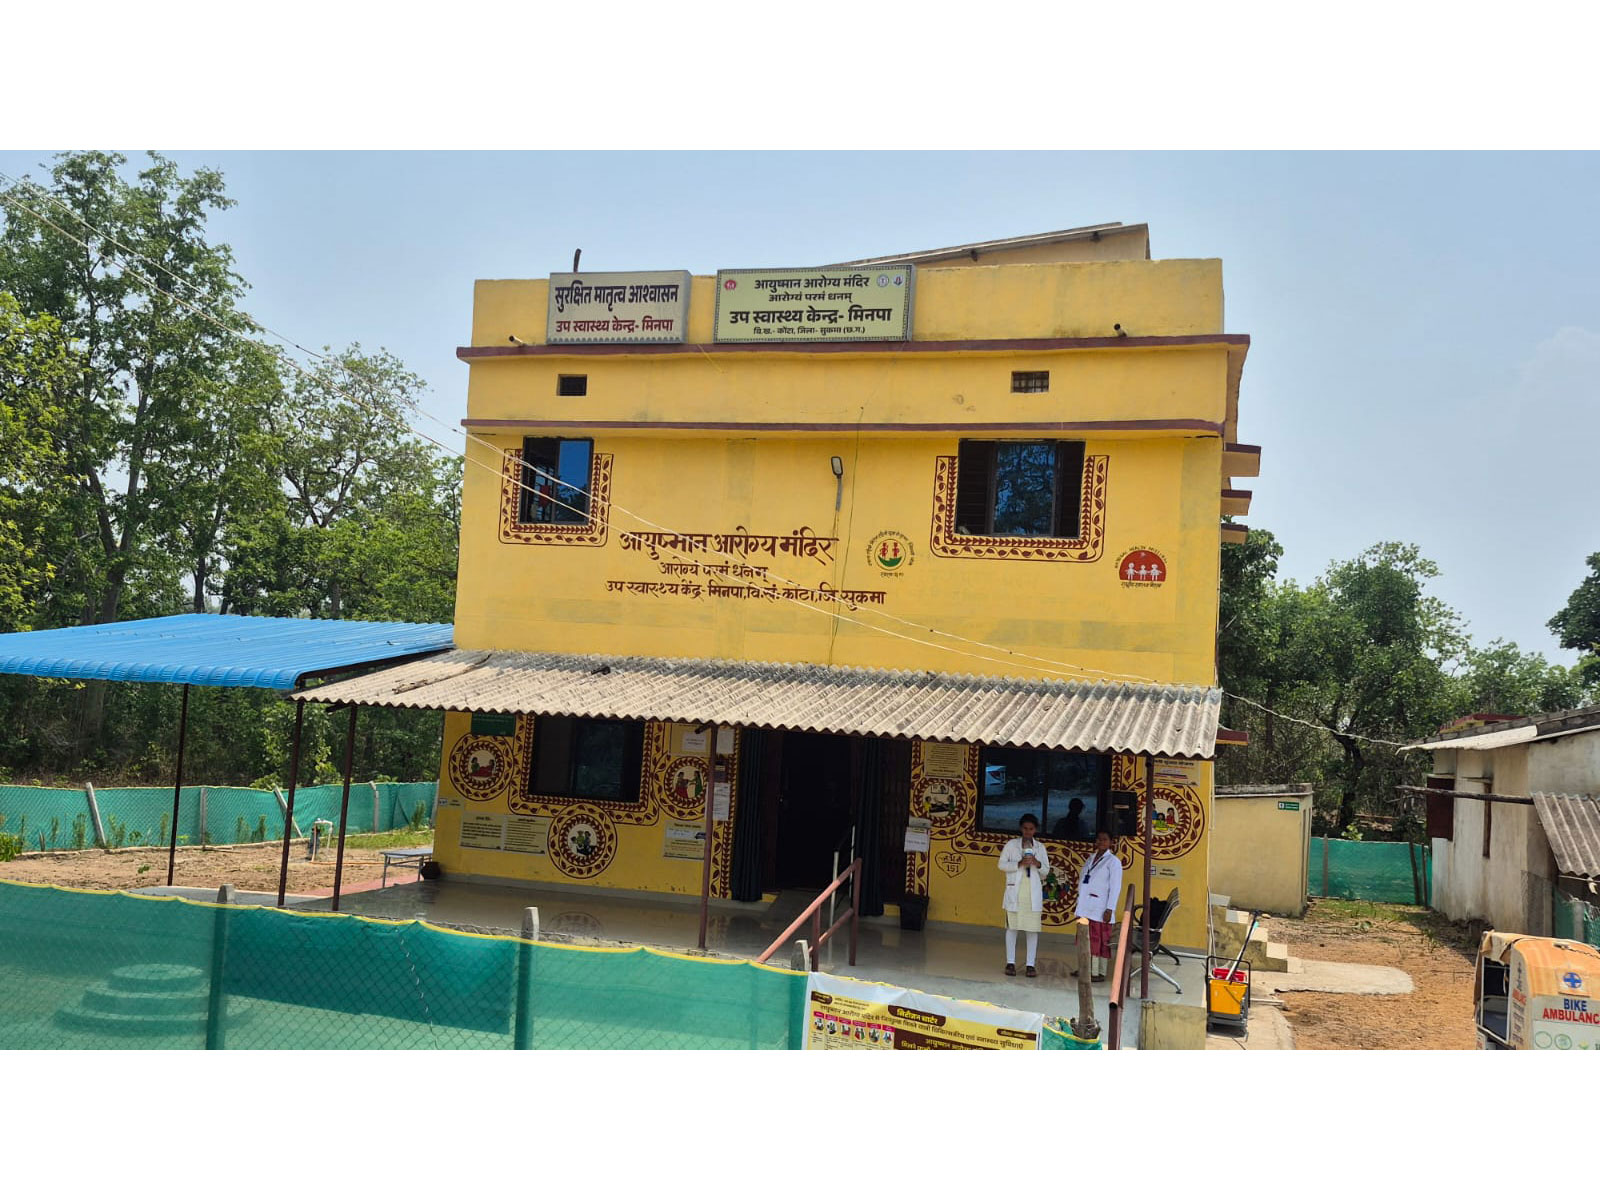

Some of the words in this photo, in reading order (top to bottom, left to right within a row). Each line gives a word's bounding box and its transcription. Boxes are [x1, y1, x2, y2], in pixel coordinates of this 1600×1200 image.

[754, 279, 801, 293] आयुष्मान
[803, 275, 841, 288] आरोग्य
[843, 274, 870, 287] मंदिर
[555, 280, 592, 312] सुरक्षित
[594, 286, 626, 312] मातृत्व
[628, 284, 679, 303] आश्वासन
[768, 291, 802, 302] आरोग्यं
[804, 291, 825, 301] परमं
[827, 292, 853, 303] धनम्
[729, 311, 750, 324] उप
[753, 310, 803, 324] स्वास्थ्य
[848, 305, 892, 322] मिनपा
[555, 320, 571, 332] उप
[573, 320, 610, 333] स्वास्थ्य
[641, 315, 673, 332] मिनपा
[620, 532, 713, 560] आयुष्मान
[710, 526, 778, 559] आरोग्य
[779, 526, 840, 566] मंदिर
[606, 581, 625, 592] उप
[627, 582, 679, 598] स्वास्थ्य
[1563, 998, 1588, 1012] BIKE
